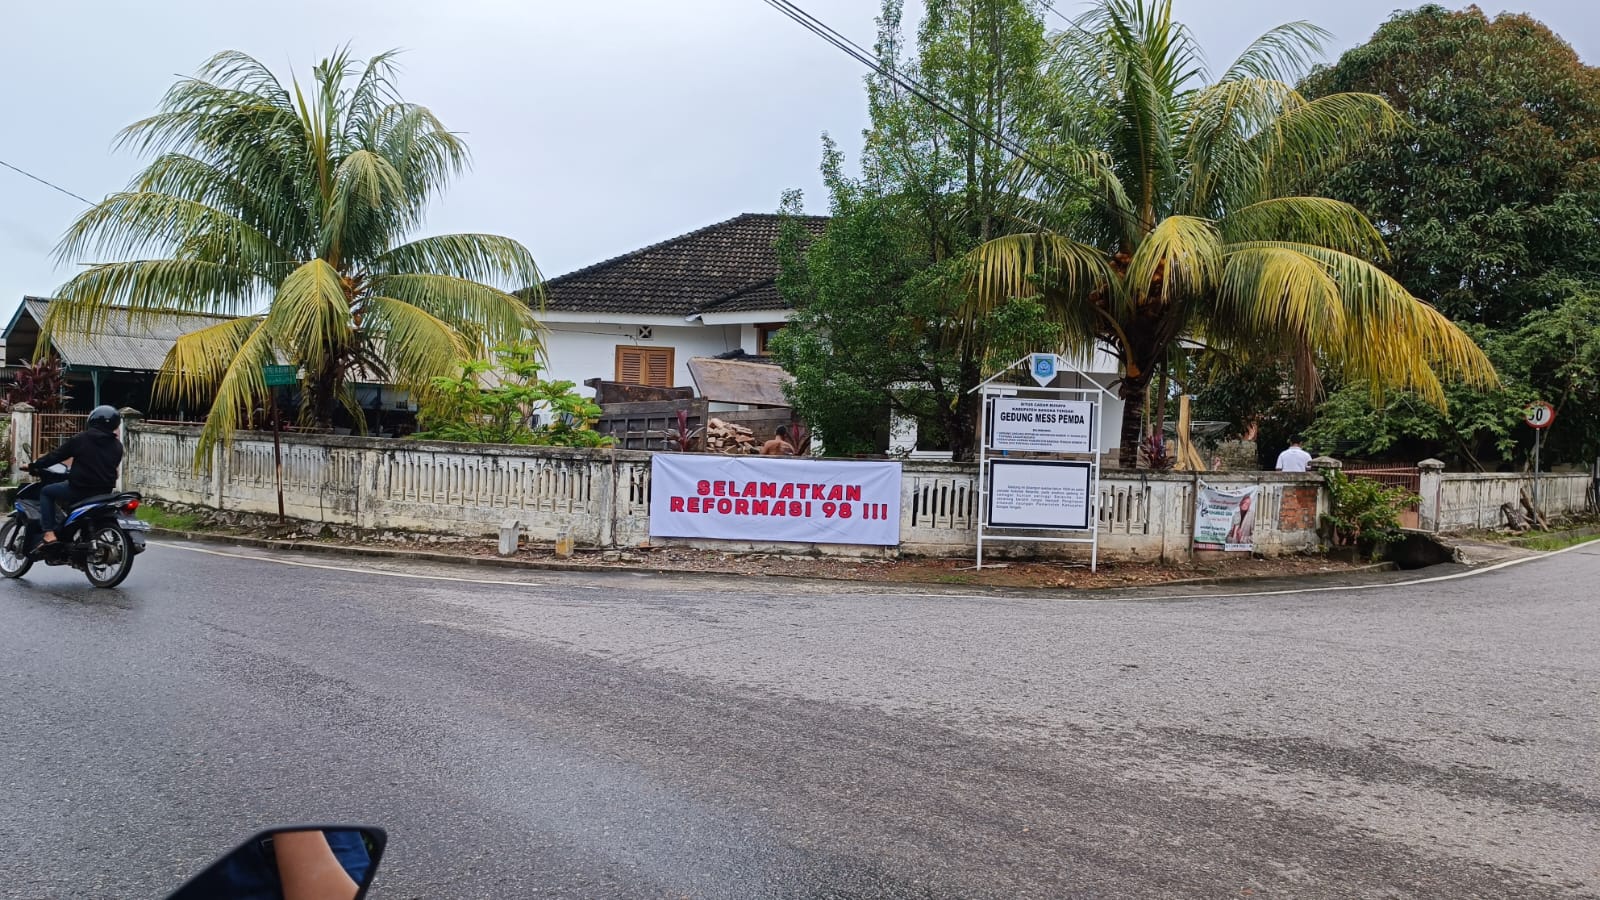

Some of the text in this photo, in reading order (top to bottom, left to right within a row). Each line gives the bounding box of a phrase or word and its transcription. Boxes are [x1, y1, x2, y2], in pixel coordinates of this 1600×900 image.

[1000, 412, 1085, 425] GEDUNG MESS PEMDA
[696, 479, 862, 501] SELAMATKAN
[670, 496, 888, 520] REFORMASI 98 !!!
